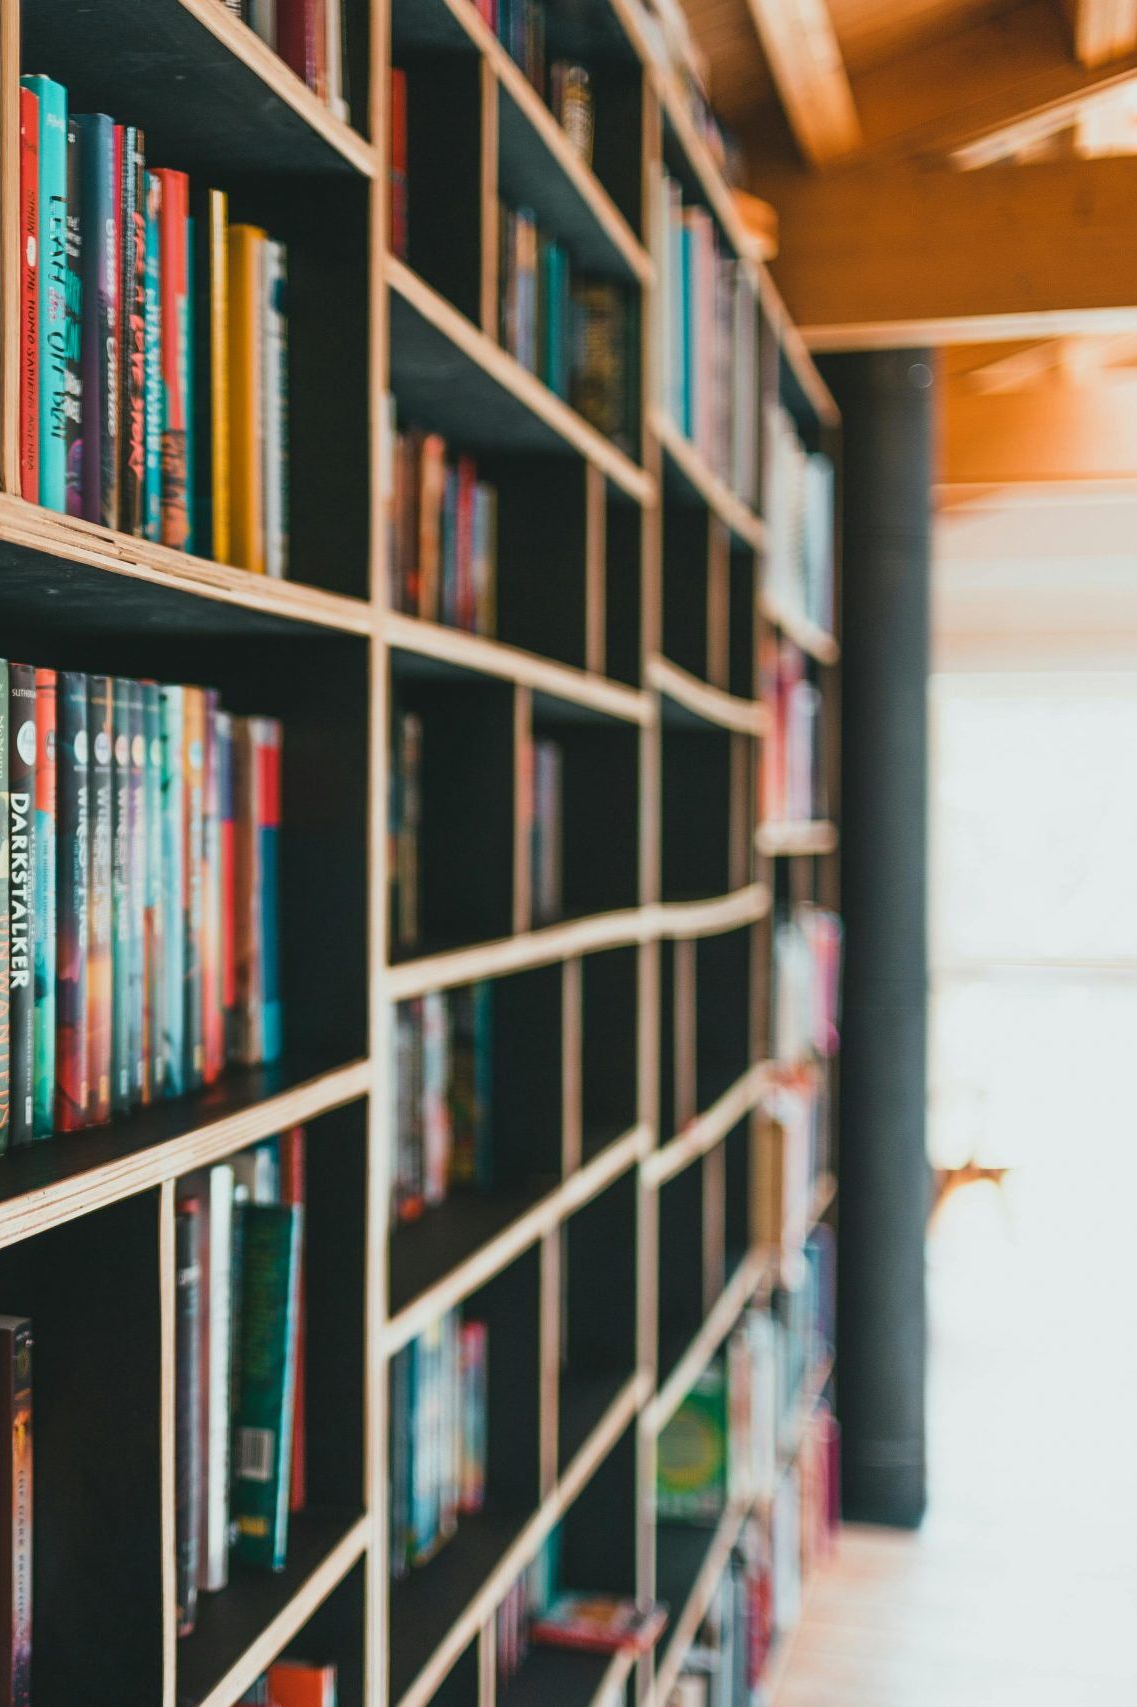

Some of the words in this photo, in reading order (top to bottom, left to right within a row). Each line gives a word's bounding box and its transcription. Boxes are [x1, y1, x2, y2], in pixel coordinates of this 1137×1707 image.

[27, 299, 36, 345] HOMO
[129, 314, 144, 386] LOVE
[26, 347, 36, 409] SAPIENS
[128, 397, 144, 481] STORY
[10, 792, 31, 990] DARKSTALKER
